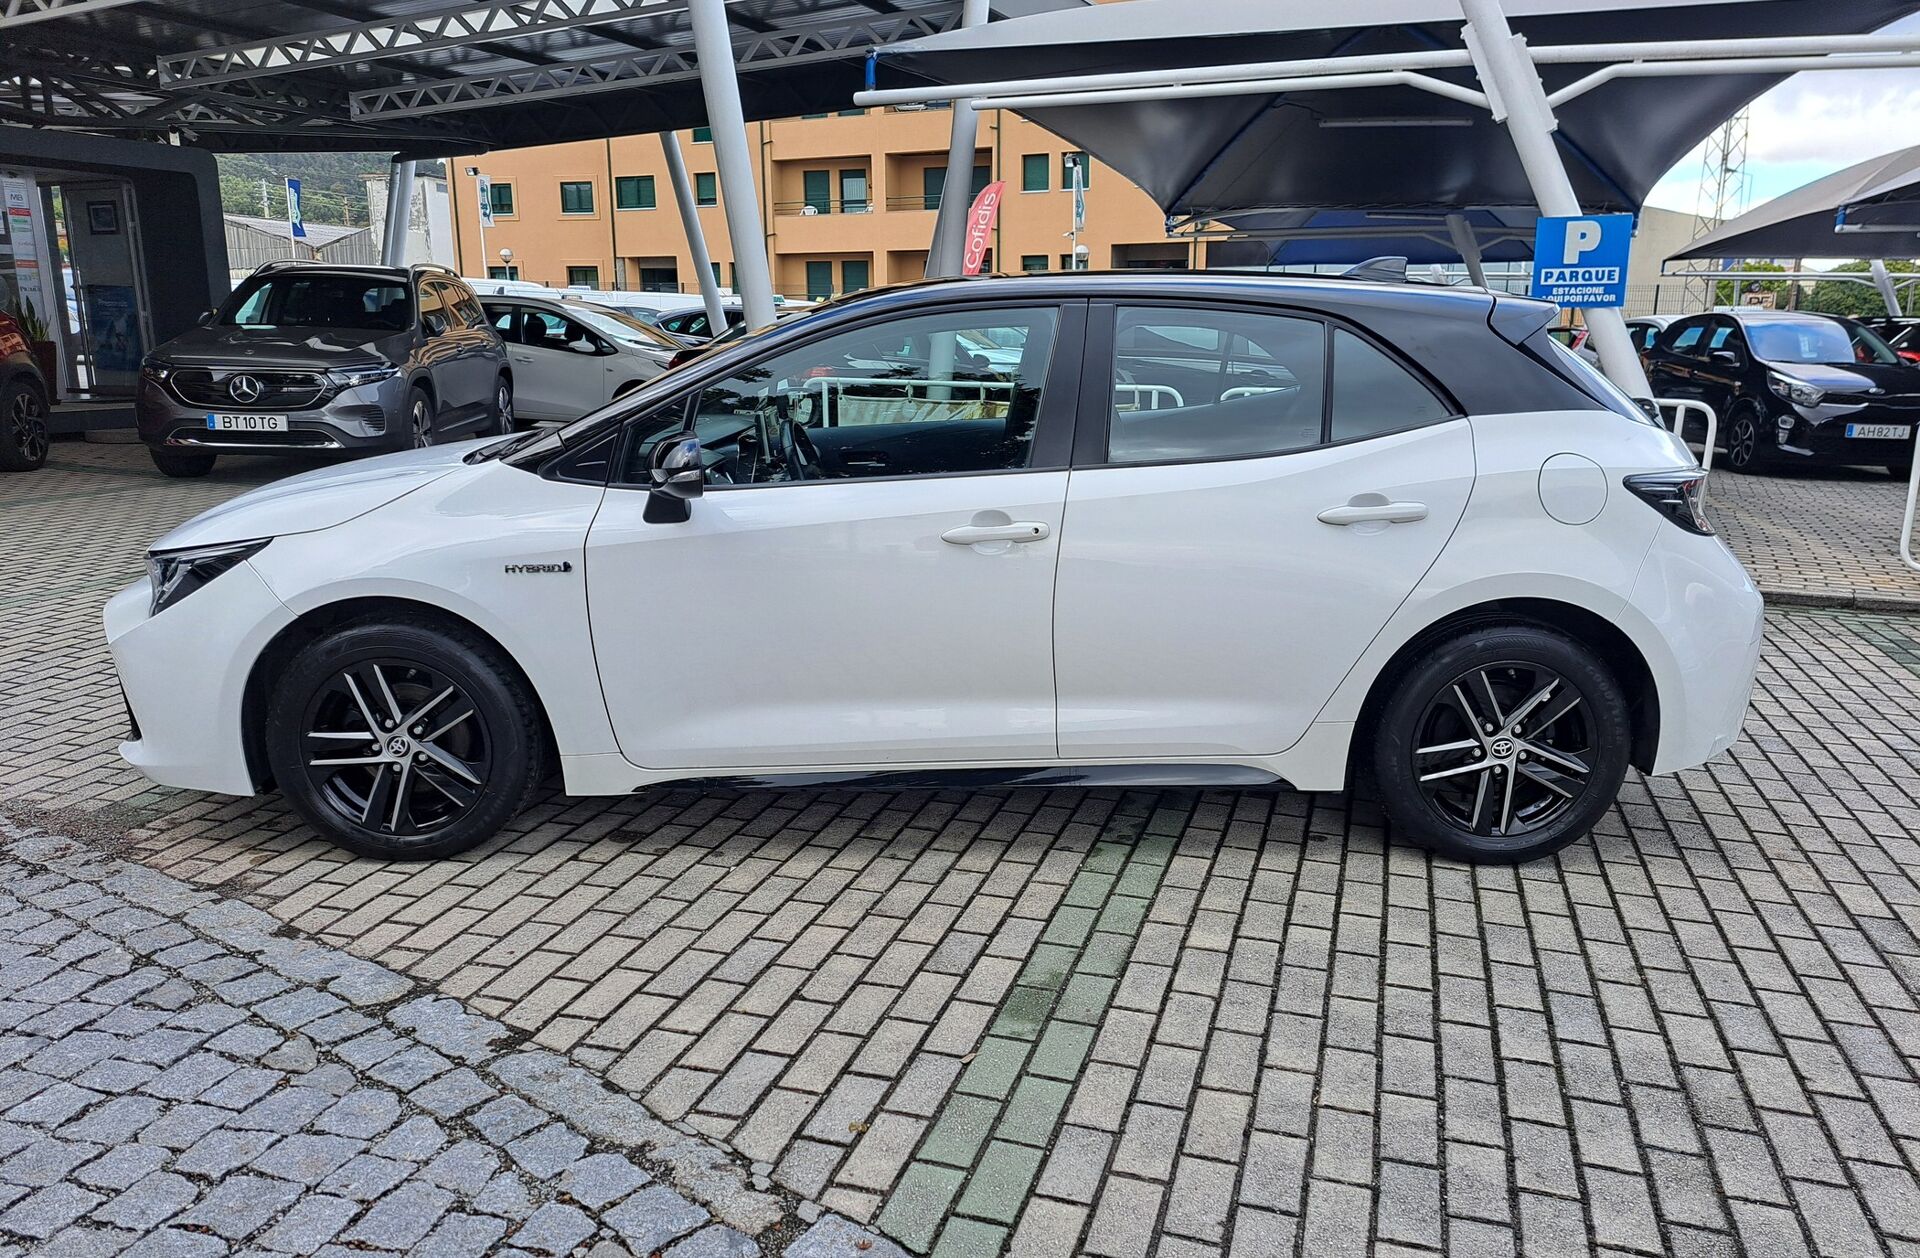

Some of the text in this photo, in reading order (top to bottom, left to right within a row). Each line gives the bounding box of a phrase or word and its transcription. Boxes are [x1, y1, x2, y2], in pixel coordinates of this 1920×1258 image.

[965, 191, 997, 269] Cofidis
[1563, 220, 1602, 265] P
[1543, 269, 1617, 283] PARQUE
[1552, 286, 1605, 295] ESTACIONE
[1564, 295, 1583, 303] POR
[1583, 294, 1616, 302] FAVOR
[1858, 426, 1906, 438] AH82TJ
[504, 564, 562, 573] HYBRID
